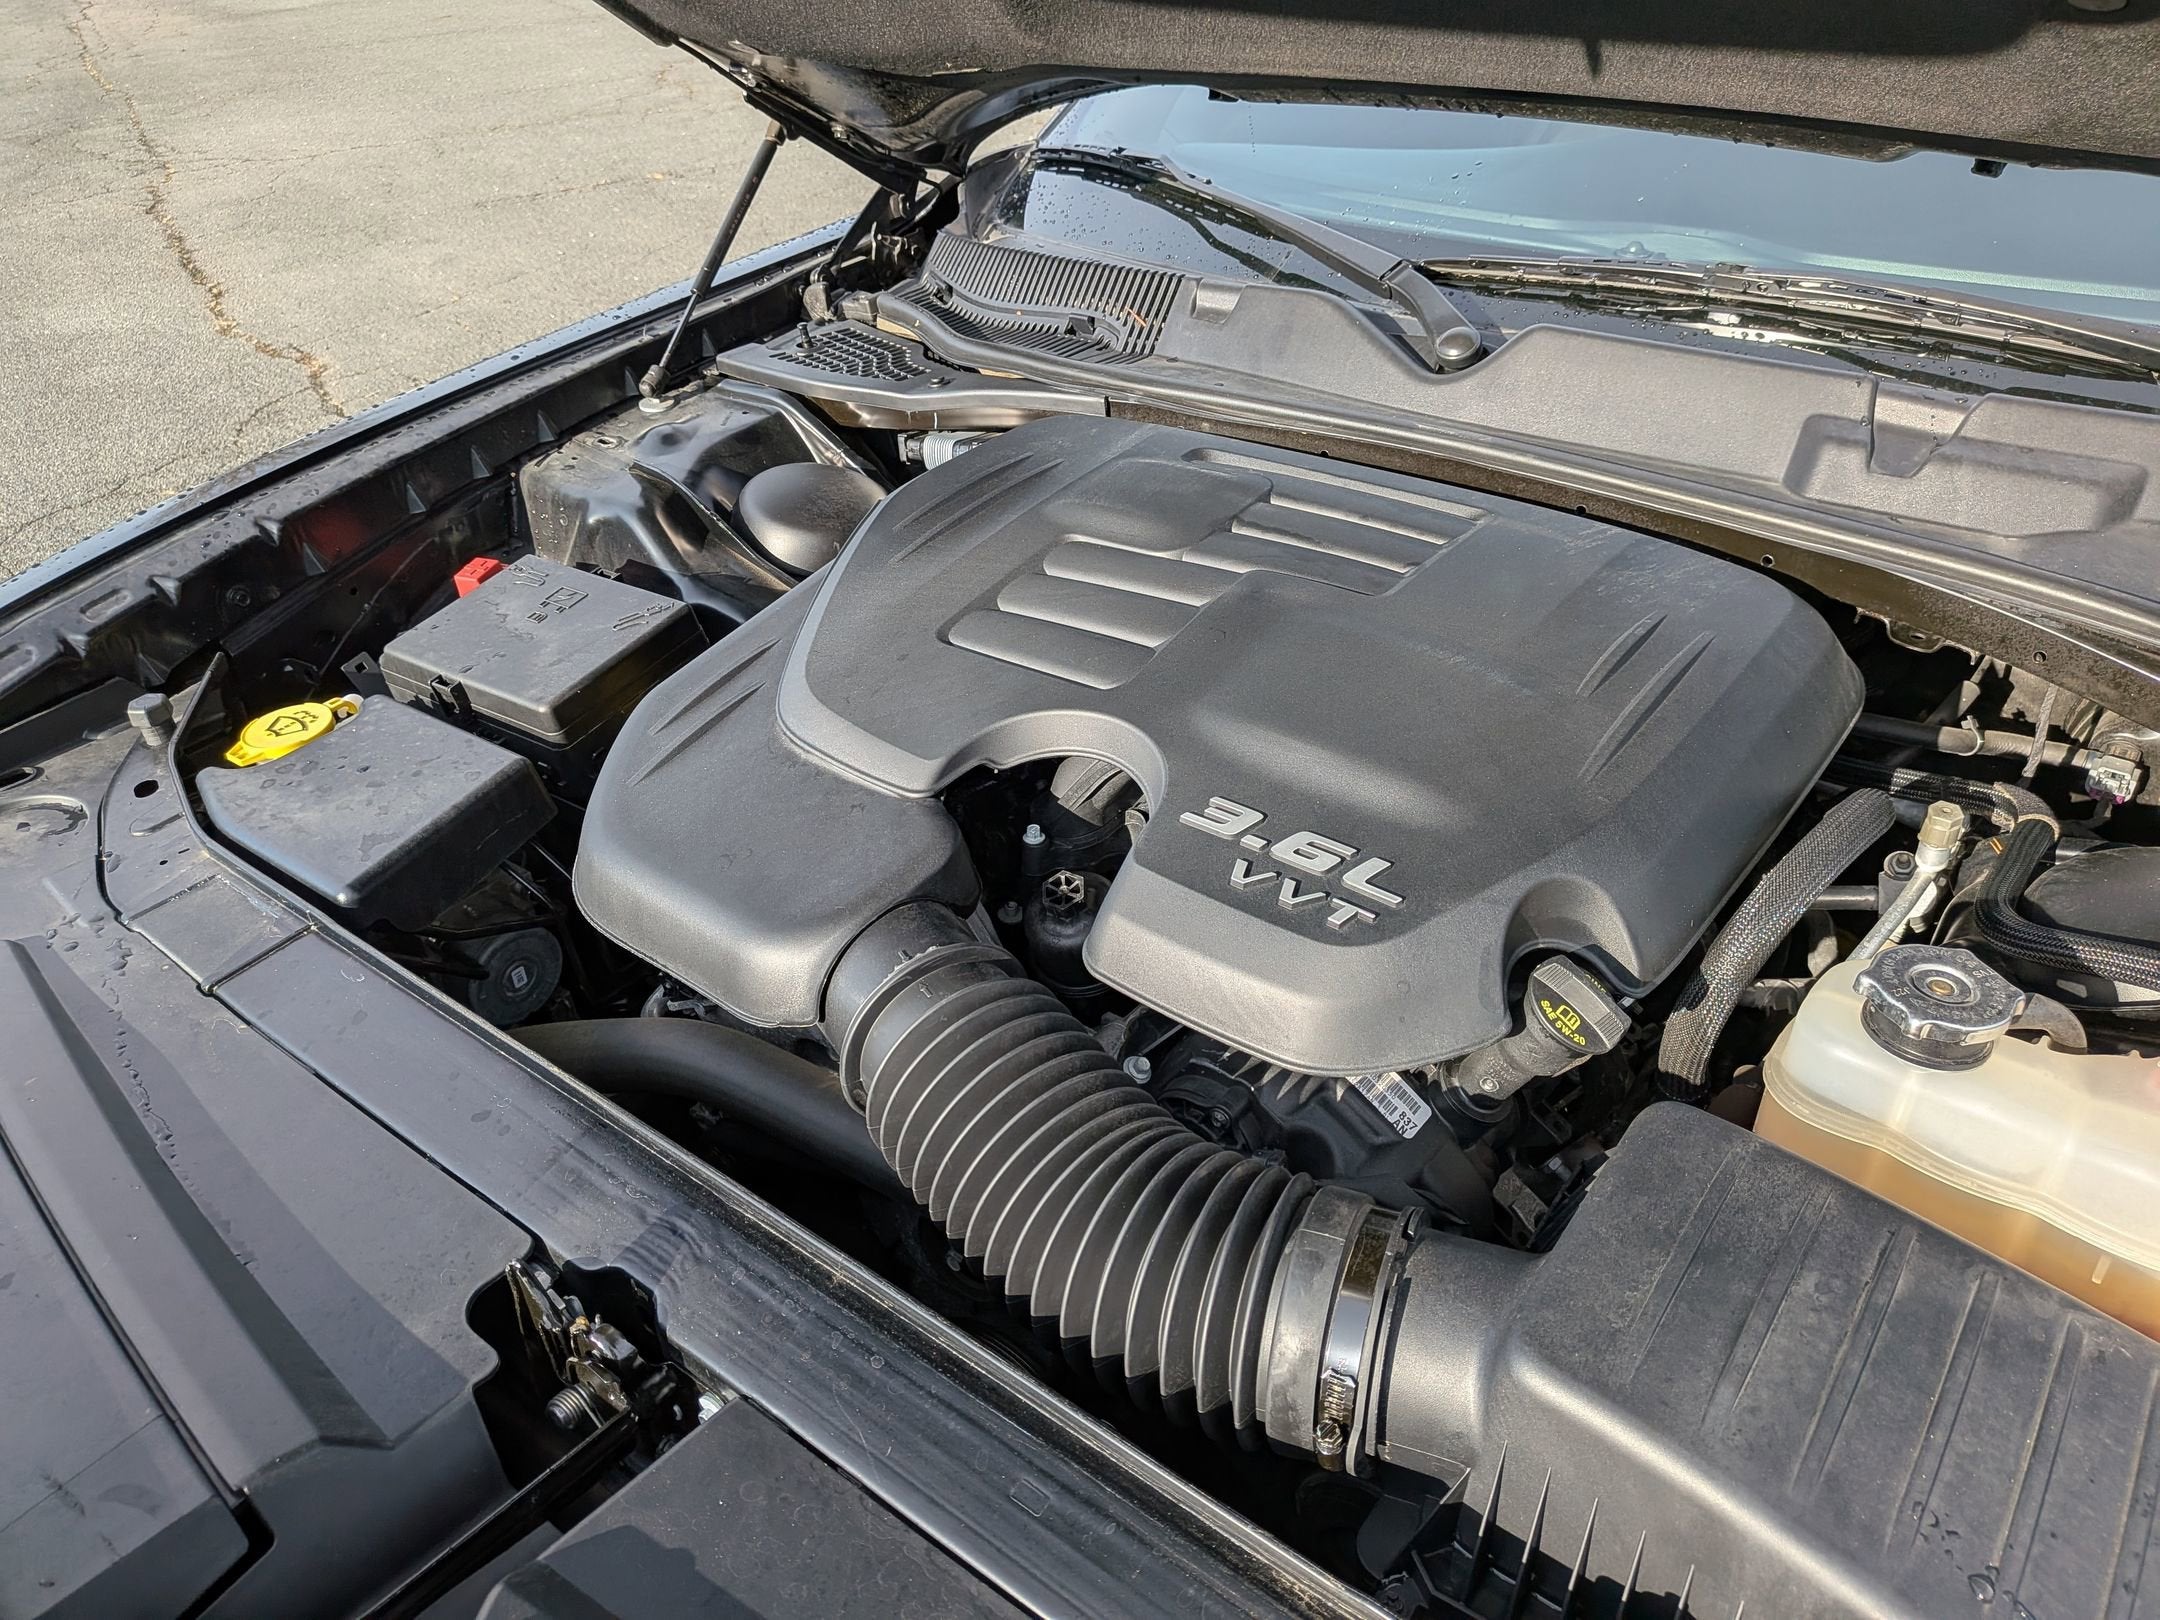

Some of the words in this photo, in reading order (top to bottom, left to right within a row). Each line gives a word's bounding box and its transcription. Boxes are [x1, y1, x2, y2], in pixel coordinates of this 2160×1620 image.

[1179, 796, 1405, 907] 3.6L
[1229, 858, 1379, 930] VVT
[1972, 967, 1996, 979] TVS
[1541, 1000, 1557, 1020] SAE
[1555, 1020, 1586, 1046] 5W-20
[1398, 1110, 1418, 1131] 837
